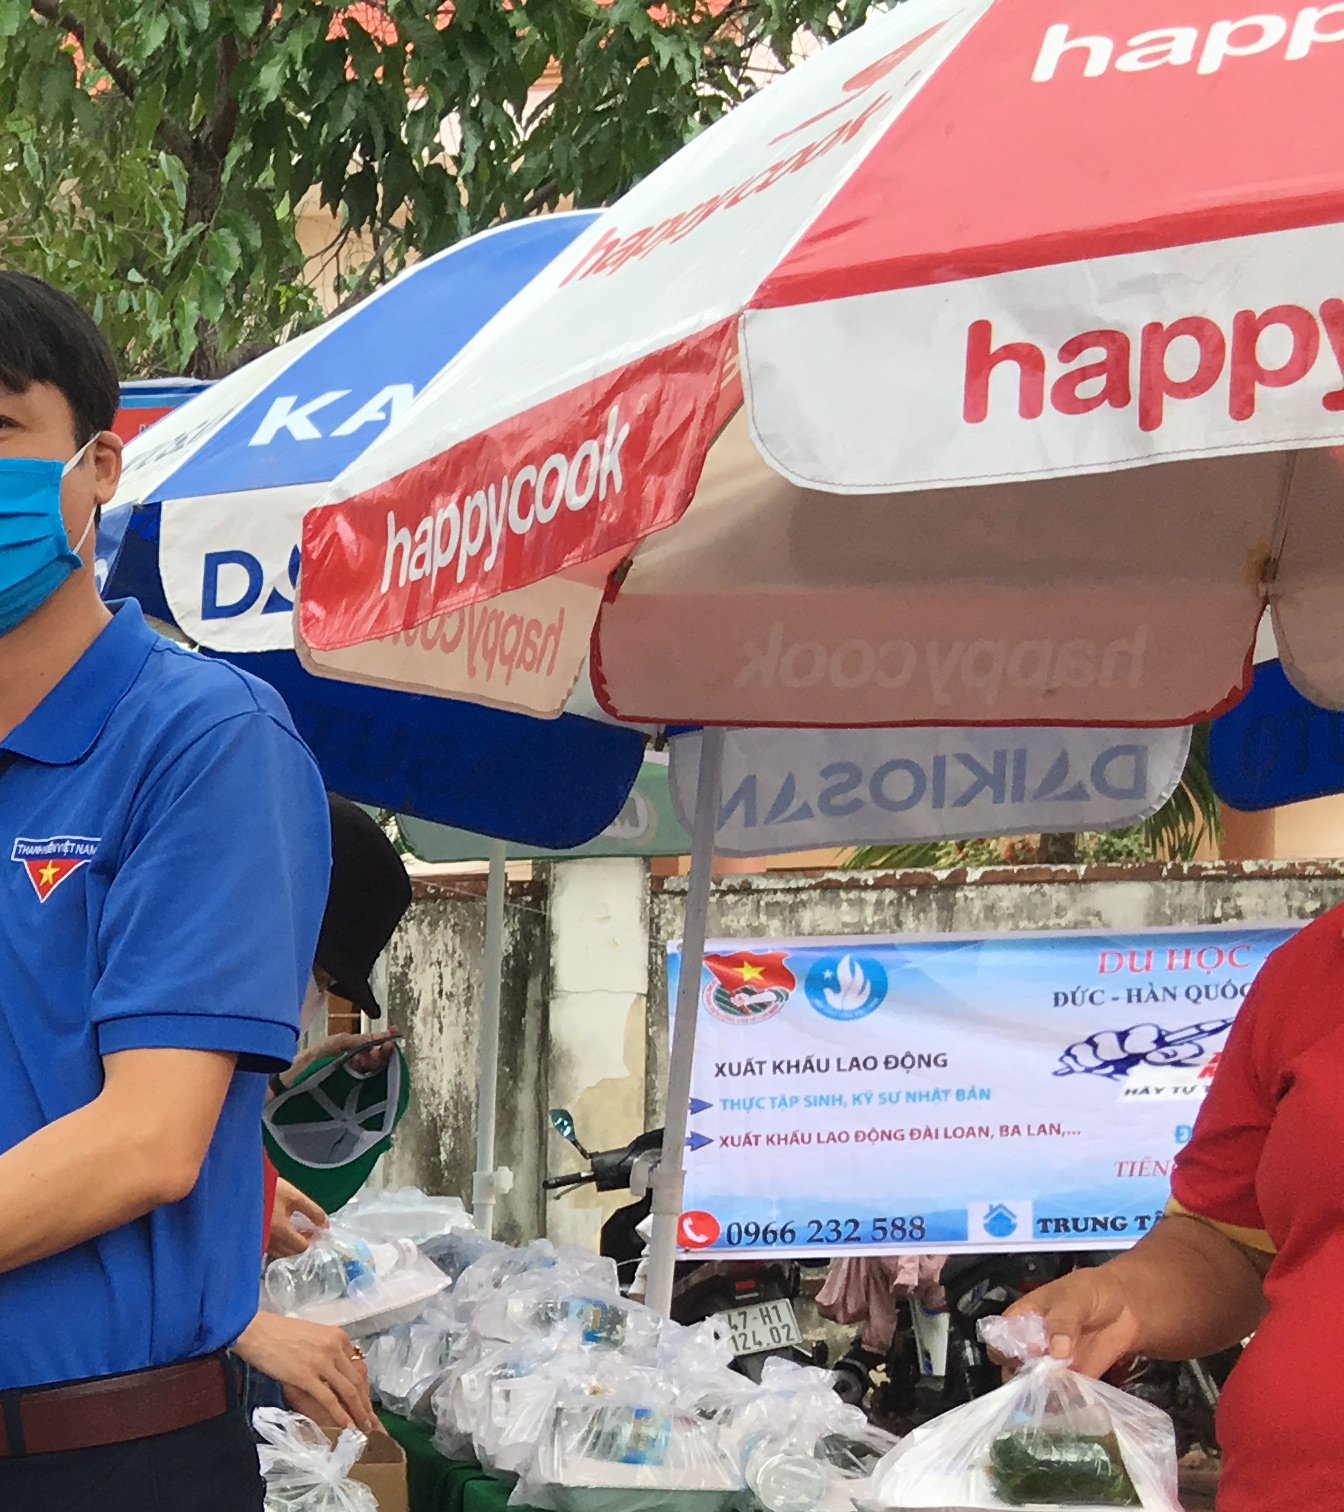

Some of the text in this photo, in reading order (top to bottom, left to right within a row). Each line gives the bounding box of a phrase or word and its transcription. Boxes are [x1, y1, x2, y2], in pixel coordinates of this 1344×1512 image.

[1031, 3, 1344, 83] happ
[963, 298, 1344, 432] happy
[381, 405, 631, 594] happycook
[1097, 944, 1252, 975] DU HỌC
[1053, 985, 1106, 1008] ĐỨC
[1126, 982, 1178, 1004] HÀN
[714, 1056, 767, 1078] XUẤT
[836, 1054, 879, 1073] LAO
[883, 1050, 949, 1075] ĐỘNG
[720, 1096, 766, 1115] THỰC
[769, 1093, 799, 1113] TẬP
[878, 1089, 901, 1106] SƯ
[905, 1086, 952, 1107] NHẬT
[719, 1131, 763, 1149] XUẤT
[816, 1130, 851, 1145] LAO
[854, 1127, 906, 1147] ĐỘNG
[909, 1124, 940, 1141] ĐÀI
[999, 1124, 1021, 1139] BA
[1114, 1155, 1174, 1178] TIẾN
[726, 1216, 927, 1247] 0966 232 588
[1037, 1215, 1129, 1234] TRUNG
[731, 1323, 795, 1352] 124.02
